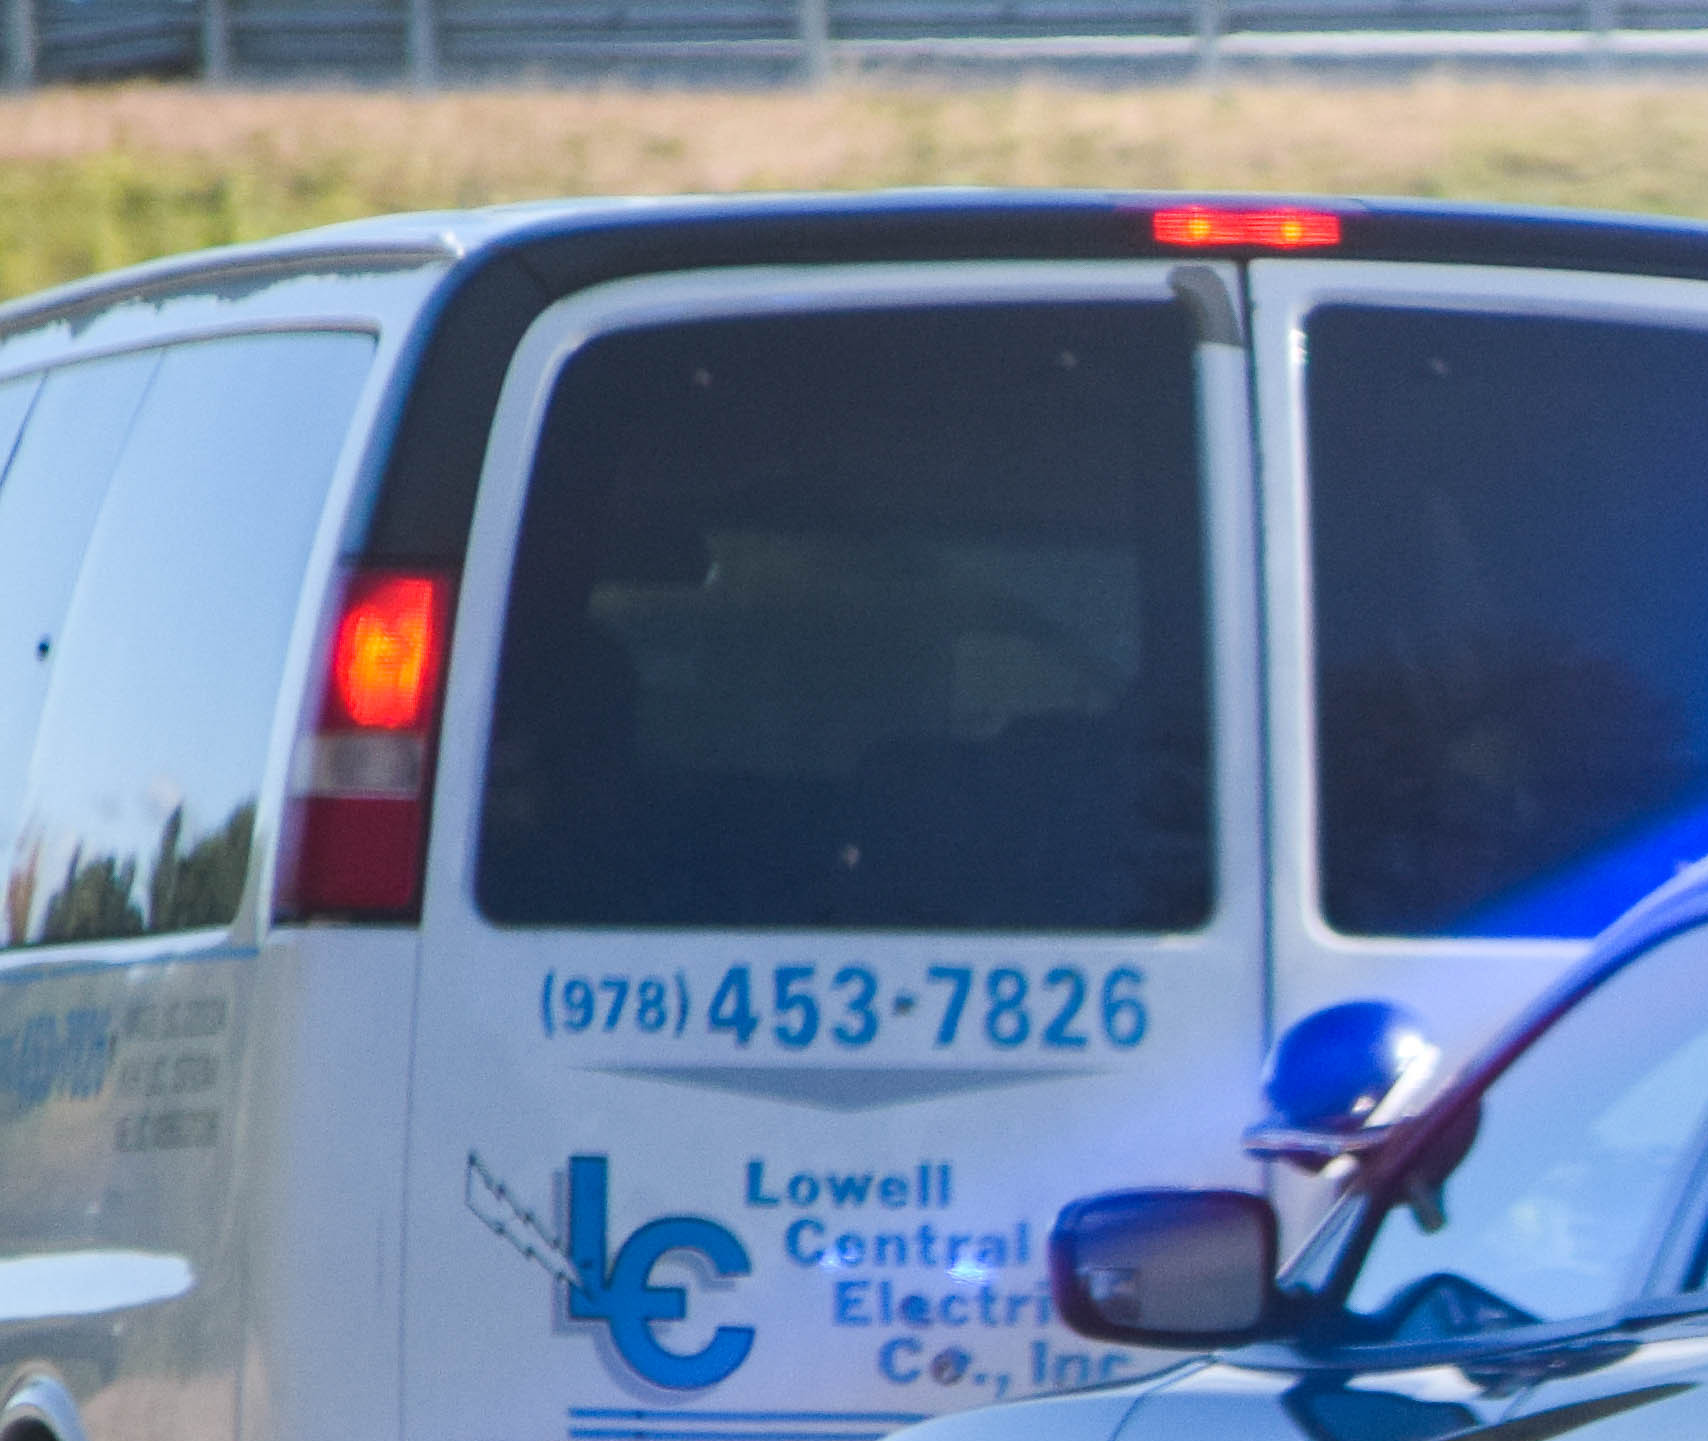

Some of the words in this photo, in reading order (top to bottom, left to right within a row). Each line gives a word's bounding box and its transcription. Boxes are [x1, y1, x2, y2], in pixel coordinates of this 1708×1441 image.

[541, 967, 690, 1040] (978)
[745, 1159, 952, 1208] Lowell
[784, 1218, 1031, 1268] Central
[833, 1279, 1053, 1326] Electri
